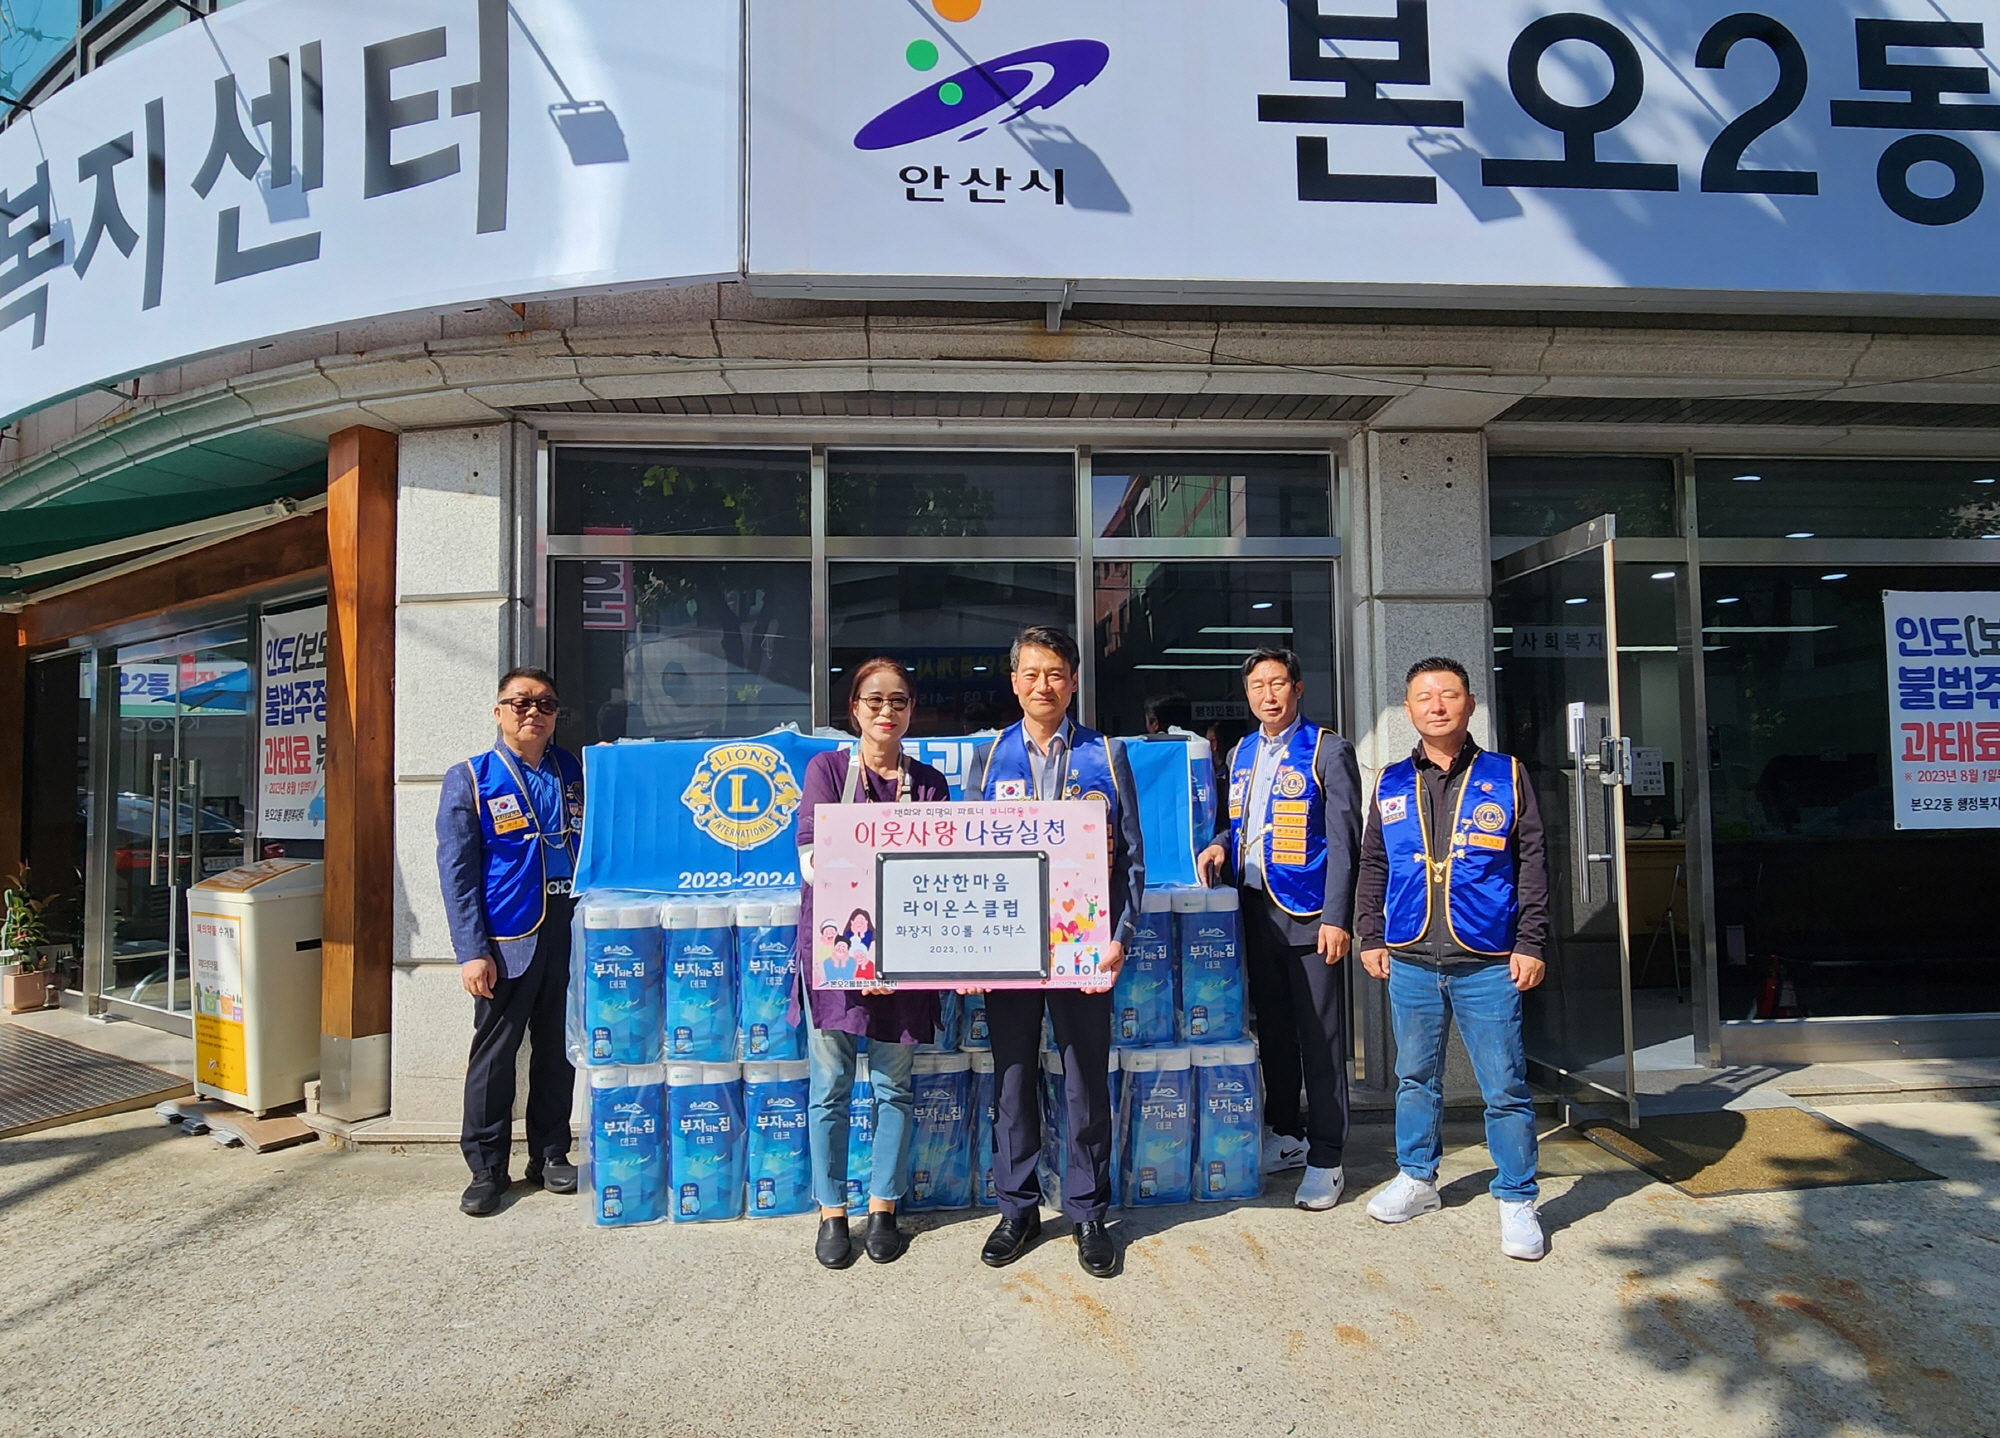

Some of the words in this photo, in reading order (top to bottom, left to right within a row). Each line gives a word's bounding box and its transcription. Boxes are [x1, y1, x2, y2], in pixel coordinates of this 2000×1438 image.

[1257, 0, 2000, 226] 본오2동
[898, 165, 1065, 205] 안산시
[264, 735, 312, 775] 과태료
[715, 748, 774, 767] LIONS
[1917, 769, 1957, 783] 2023년
[1960, 769, 1978, 783] 8월
[727, 774, 759, 813] L
[957, 807, 984, 816] 파트너
[1911, 798, 1954, 812] 본오2동
[713, 820, 774, 839] INTERNATIONAL
[854, 820, 957, 848] 이웃사랑
[965, 819, 1067, 846] 나눔실천
[678, 872, 796, 889] 2023~2024
[912, 873, 1010, 893] 안산한마음
[903, 899, 1019, 918] 라이온스클럽
[895, 925, 932, 939] 화장지
[941, 925, 974, 938] 30롤
[982, 924, 1027, 938] 45박스
[1190, 943, 1235, 959] 부자되는집
[593, 962, 645, 978] 부자되는집
[673, 961, 724, 977] 부자되는집
[1141, 1103, 1187, 1119] 부자되는집
[1207, 1097, 1254, 1113] 부자되는집
[604, 1118, 655, 1136] 부자되는집
[680, 1118, 730, 1134] 부자되는집
[756, 1113, 806, 1130] 부자되는집
